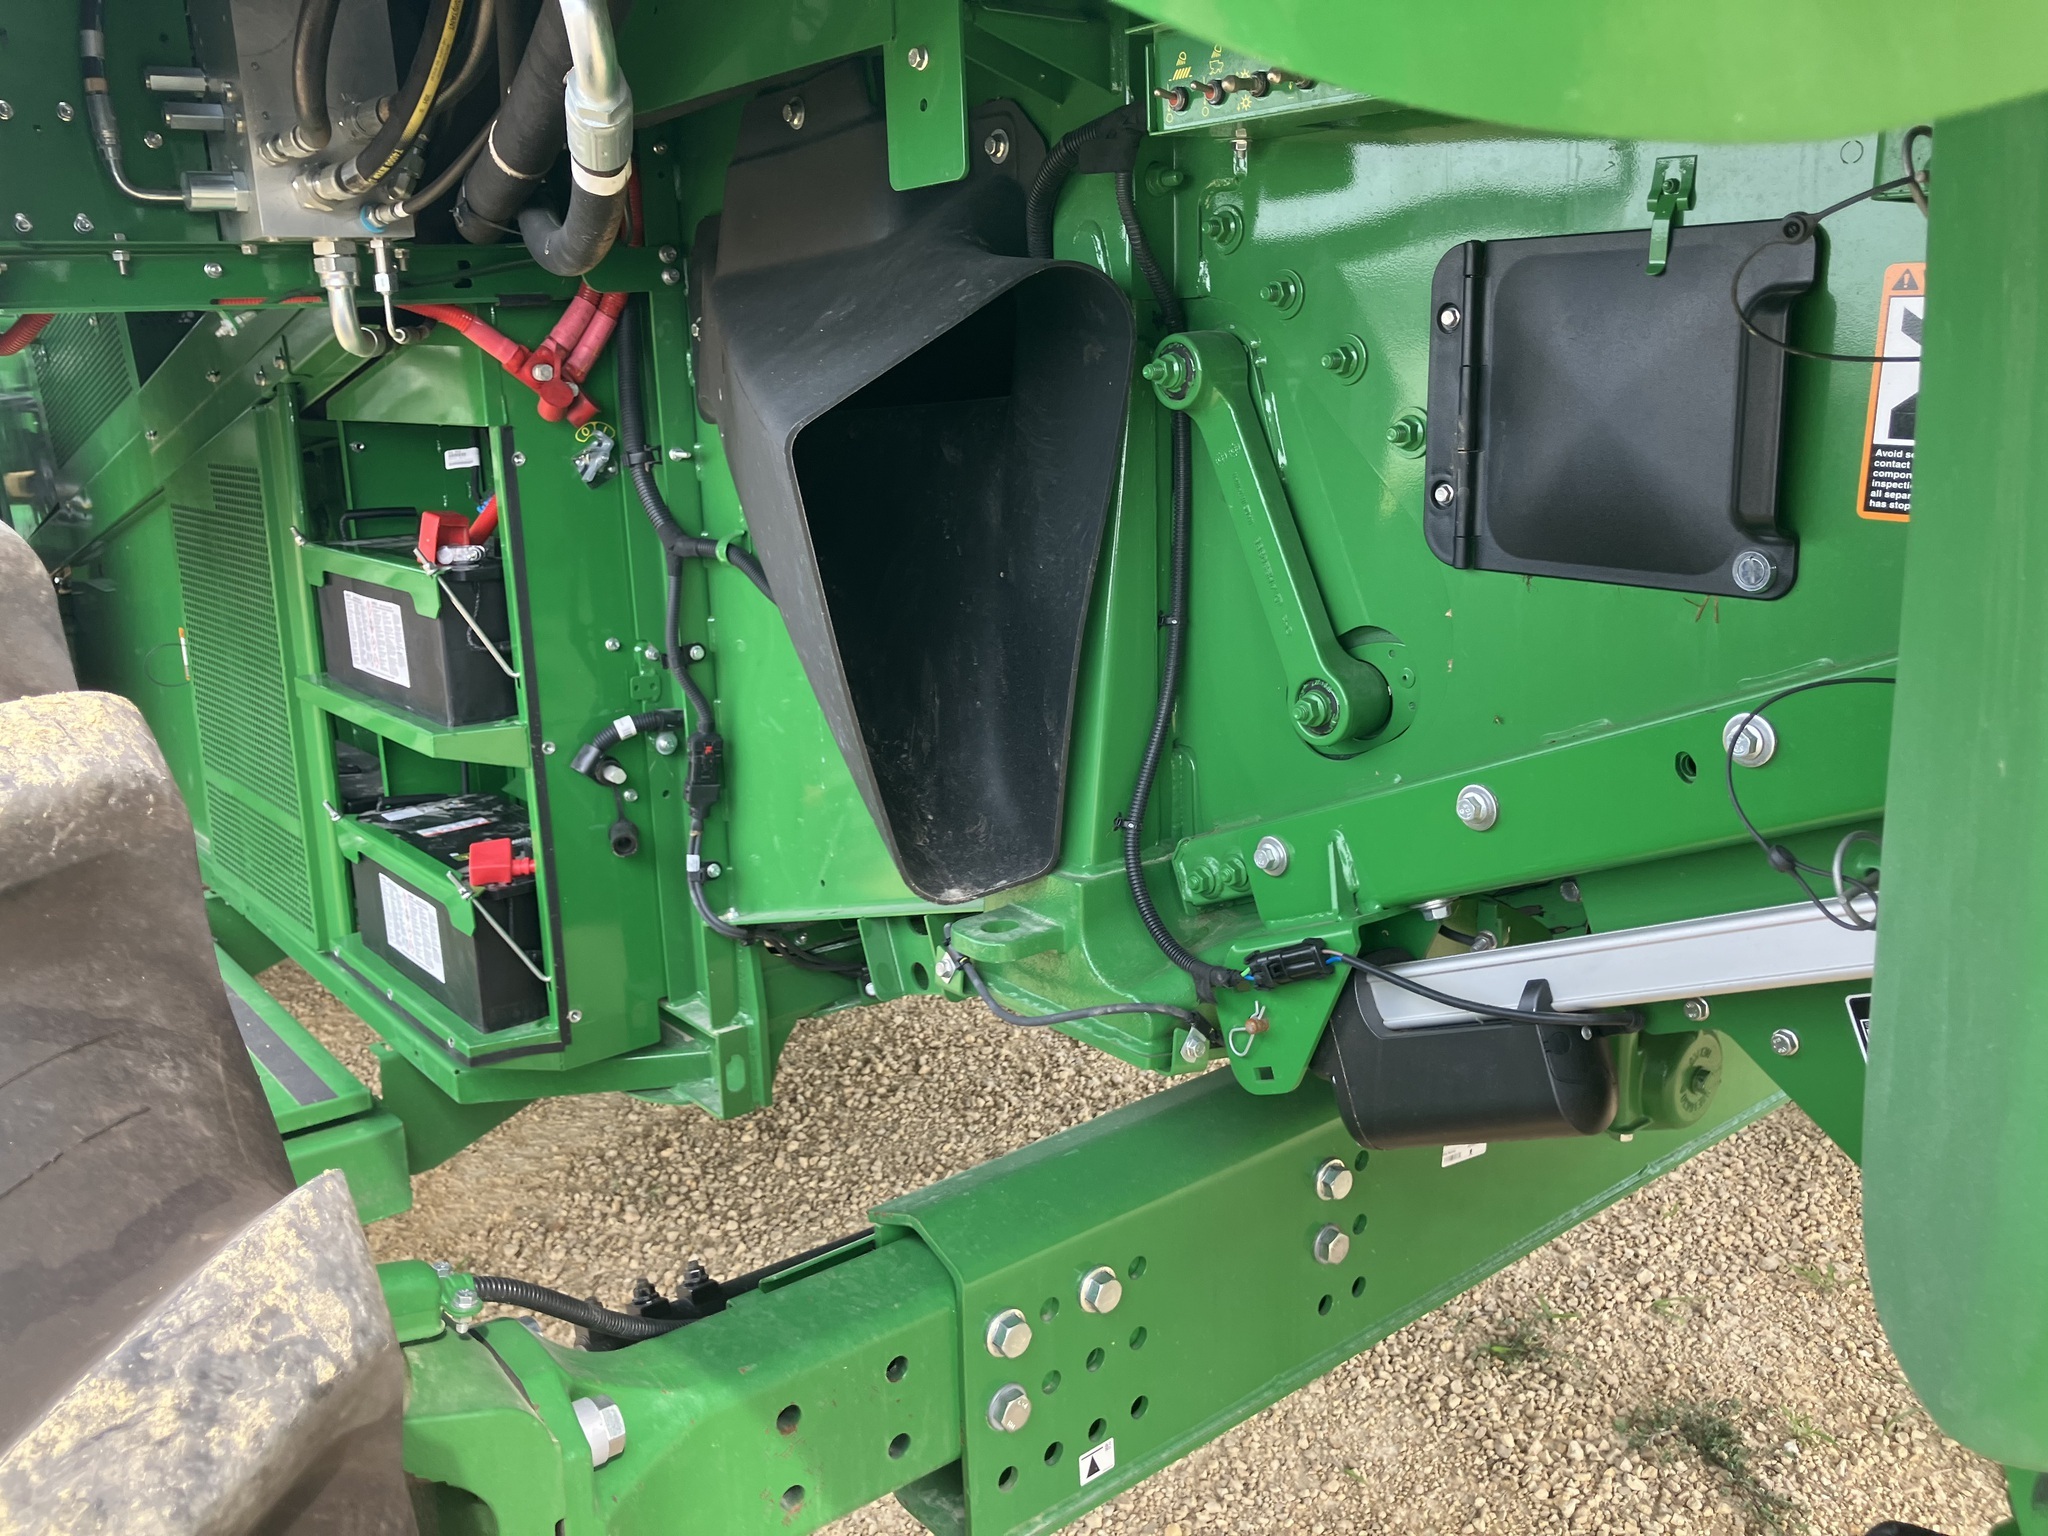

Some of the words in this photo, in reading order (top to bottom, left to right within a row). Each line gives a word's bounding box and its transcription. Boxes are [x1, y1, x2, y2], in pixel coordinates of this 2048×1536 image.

[1875, 449, 1903, 458] Avoid
[1873, 460, 1911, 469] contact
[1870, 490, 1882, 498] all
[1869, 499, 1887, 508] has
